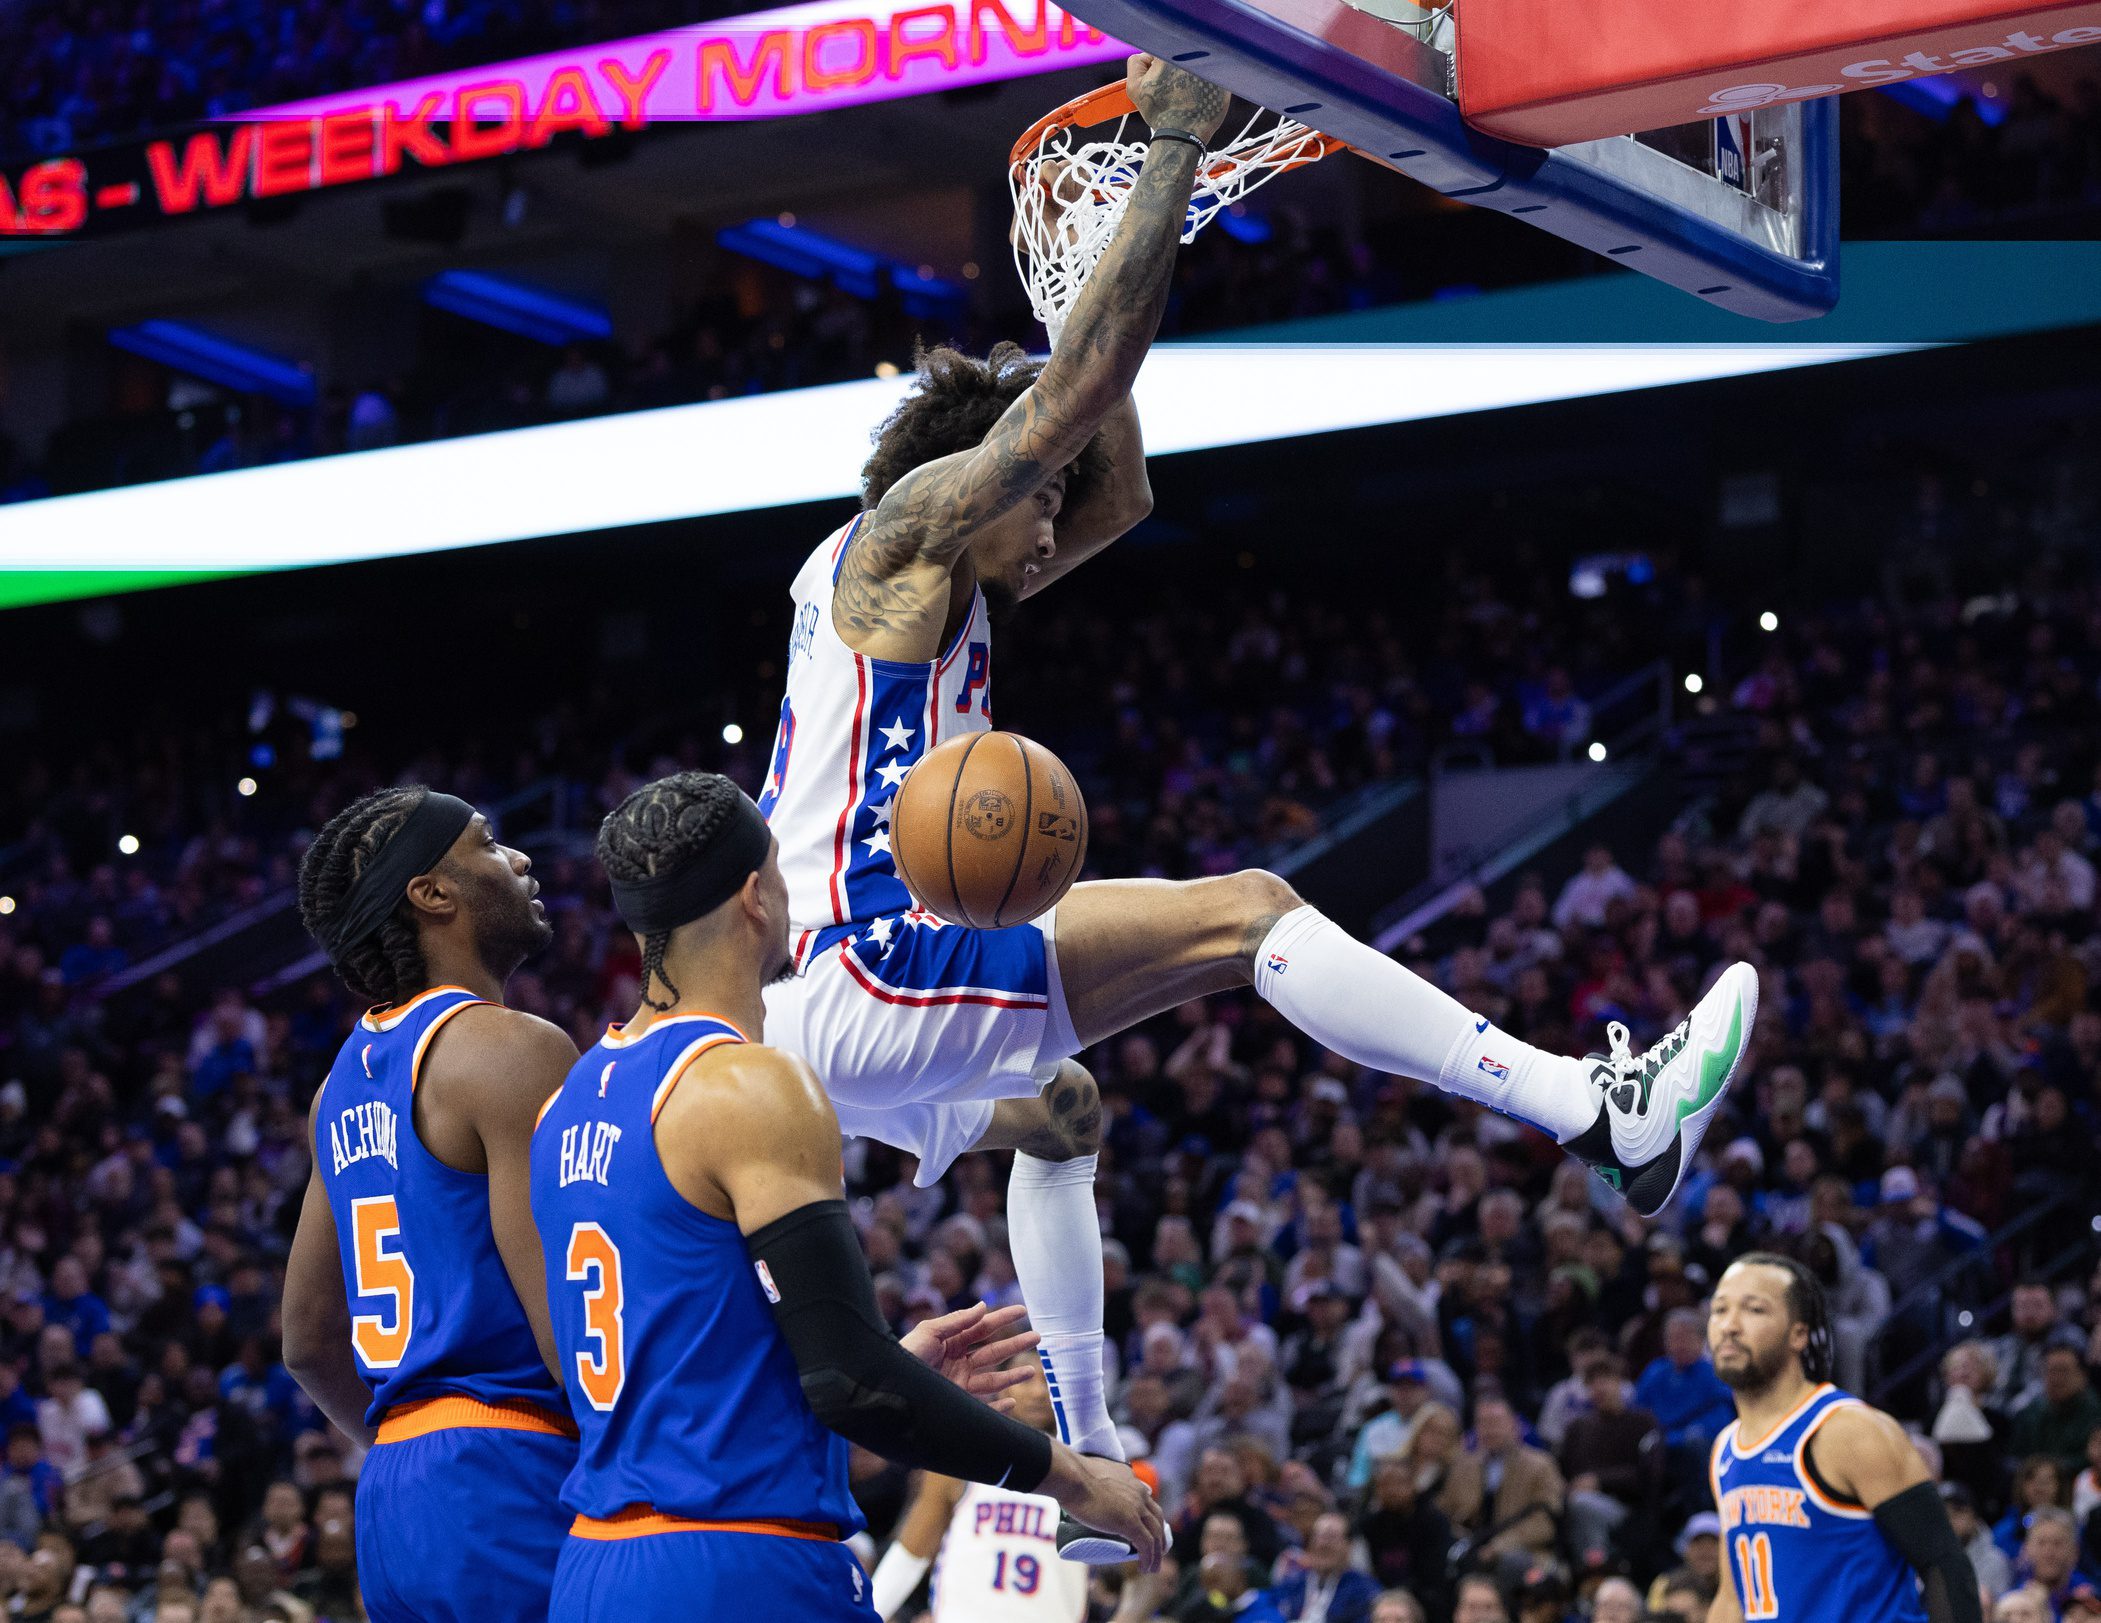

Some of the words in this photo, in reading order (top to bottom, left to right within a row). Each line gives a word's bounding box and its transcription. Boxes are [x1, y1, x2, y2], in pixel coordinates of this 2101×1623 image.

[1840, 26, 2101, 84] State
[146, 48, 673, 215] WEEKDAY
[697, 0, 1104, 114] MORNI
[1721, 147, 1740, 182] NBA
[559, 1121, 622, 1189] HART
[351, 1195, 414, 1369] 5
[566, 1222, 625, 1412] 3
[973, 1502, 1057, 1543] PHIL
[1743, 1485, 1811, 1529] YORK
[992, 1550, 1042, 1596] 19
[1735, 1531, 1779, 1620] 11
